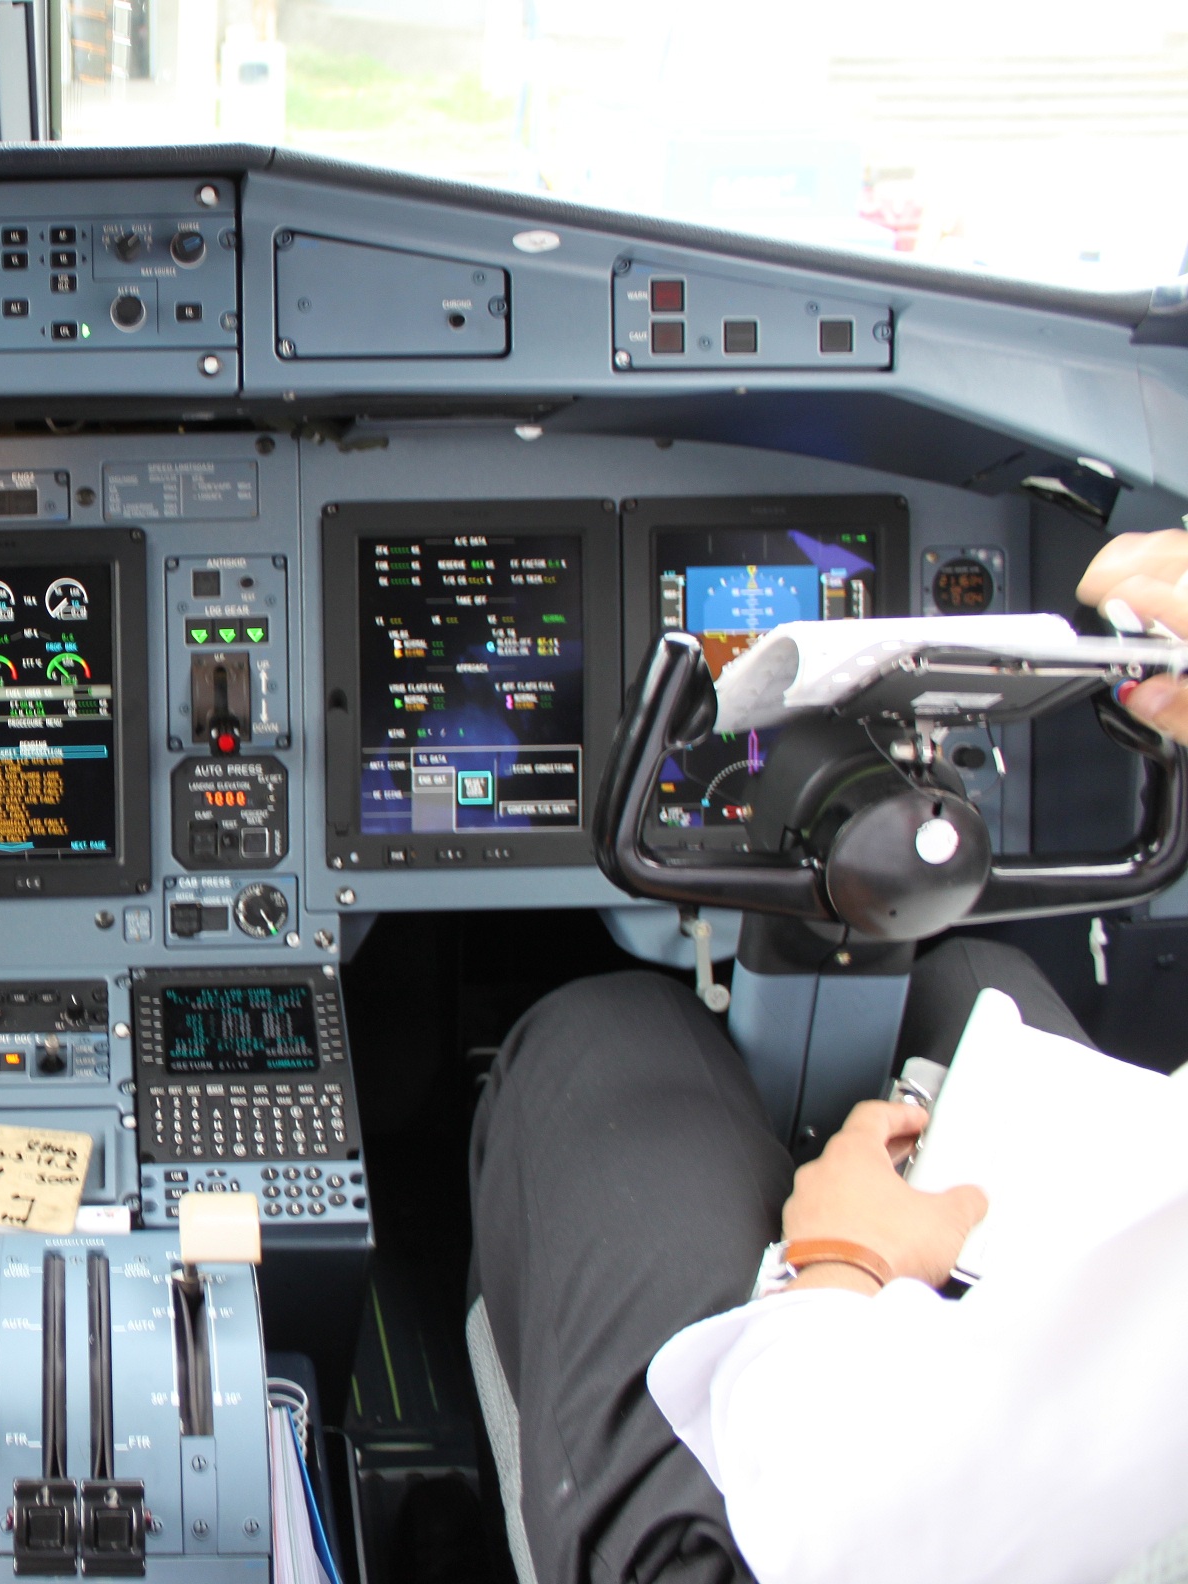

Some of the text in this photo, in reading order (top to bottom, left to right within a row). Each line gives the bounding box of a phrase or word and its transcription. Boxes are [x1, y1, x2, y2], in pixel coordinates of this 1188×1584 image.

[207, 558, 247, 569] ANTISKID
[225, 605, 250, 616] GEAR
[253, 723, 279, 733] DOWN
[195, 764, 263, 777] AUTO PRESS
[217, 782, 251, 791] ELEVATION
[202, 877, 232, 888] PRESS
[127, 1319, 156, 1331] AUTO
